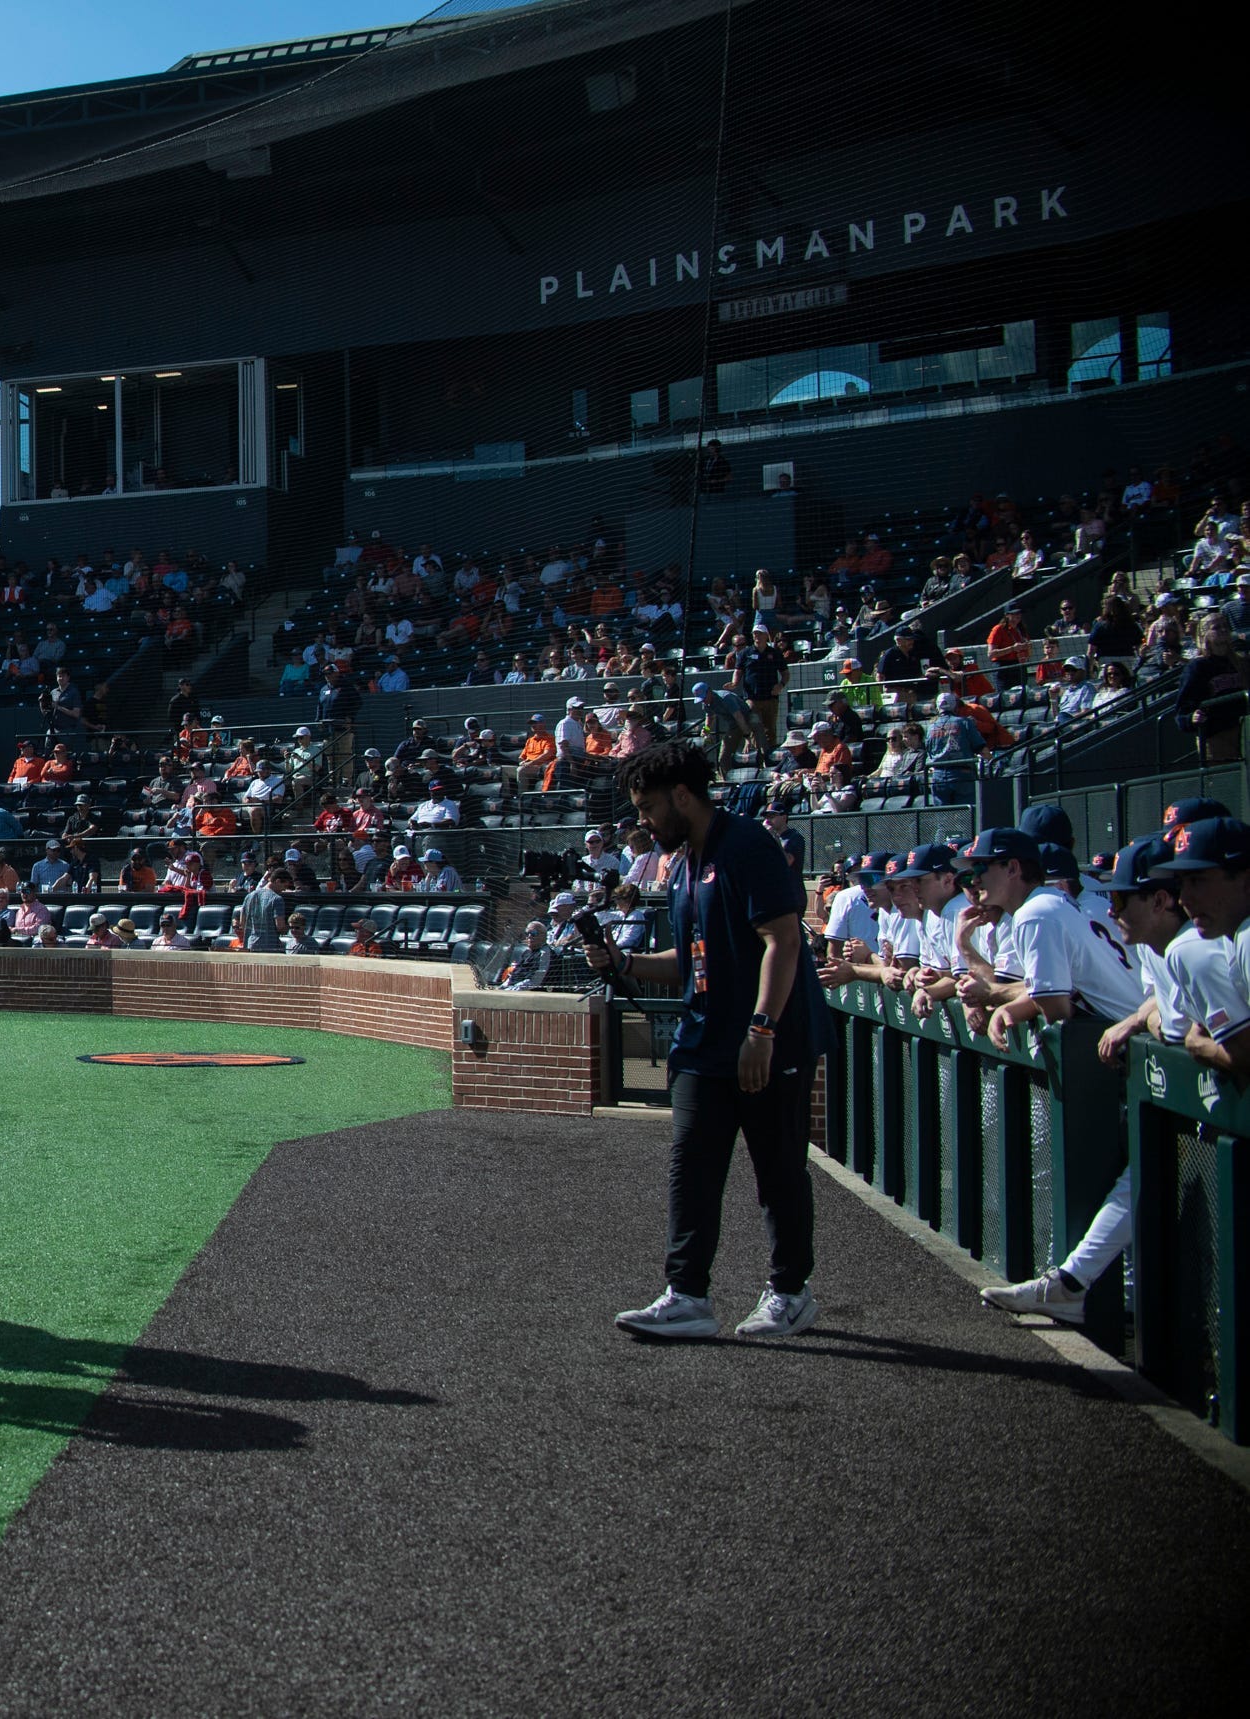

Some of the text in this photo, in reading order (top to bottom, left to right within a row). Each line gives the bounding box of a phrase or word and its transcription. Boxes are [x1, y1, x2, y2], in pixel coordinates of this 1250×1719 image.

[540, 185, 1068, 305] PLAINSMAN PARK
[823, 671, 836, 681] 106
